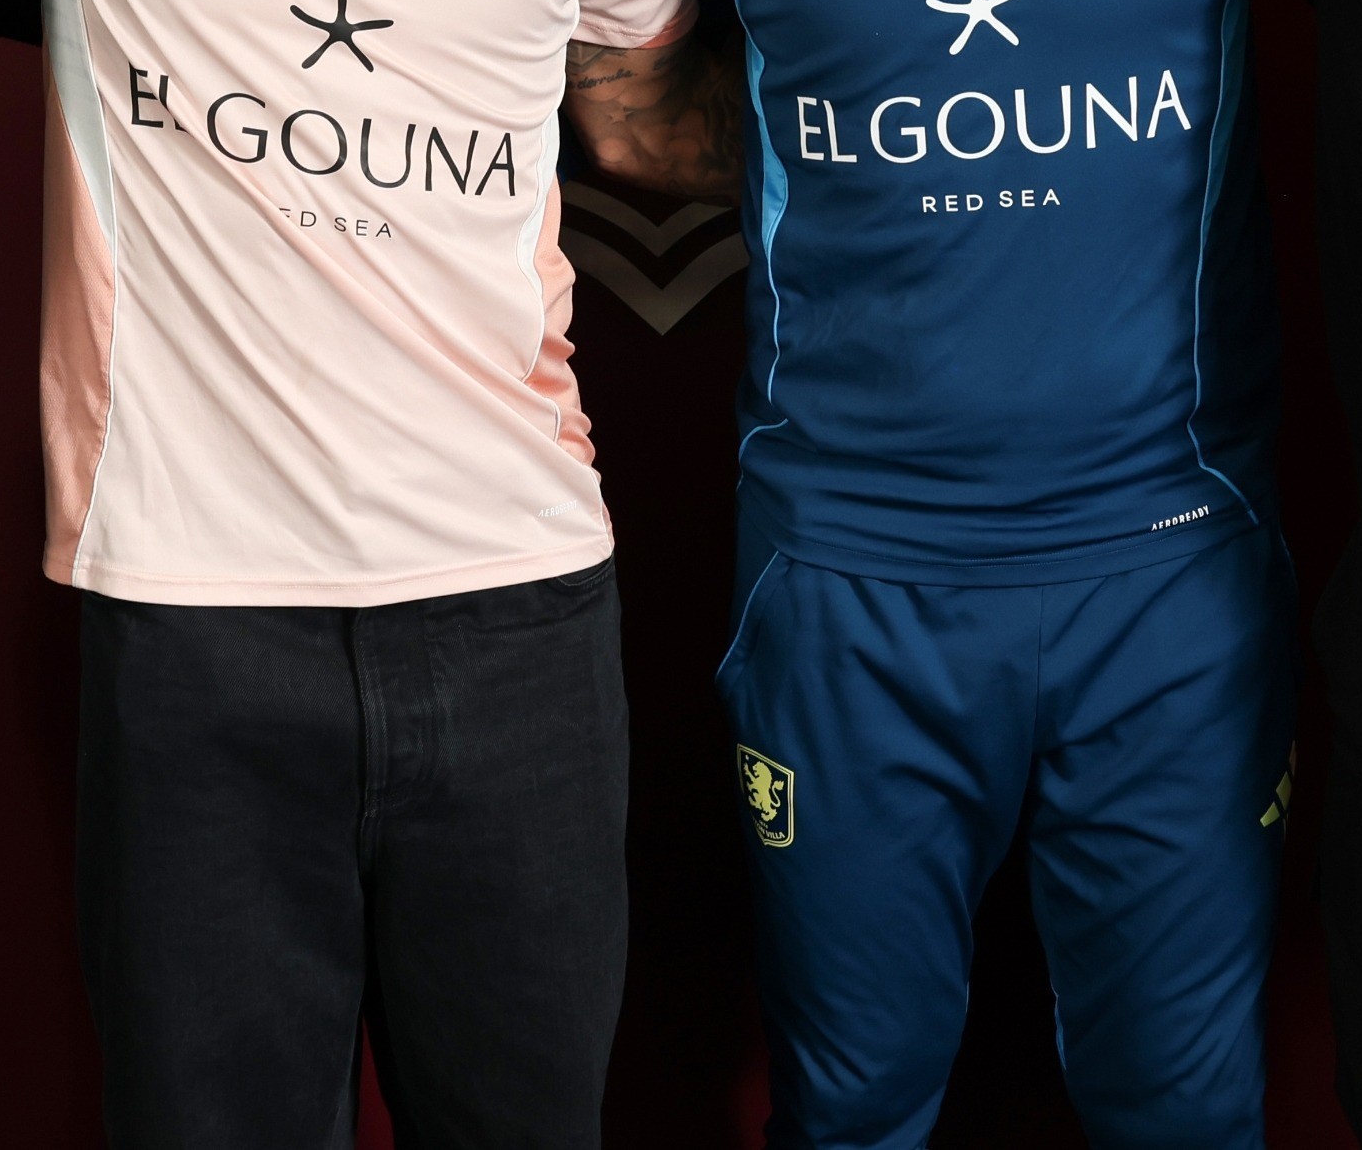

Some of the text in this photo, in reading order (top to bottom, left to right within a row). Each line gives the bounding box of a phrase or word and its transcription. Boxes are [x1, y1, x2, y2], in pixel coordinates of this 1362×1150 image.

[797, 69, 1192, 164] EL GOUNA
[206, 92, 517, 197] GOUNA
[922, 188, 1061, 214] RED SEA
[334, 216, 392, 238] SEA
[1151, 505, 1210, 531] AEROREADY
